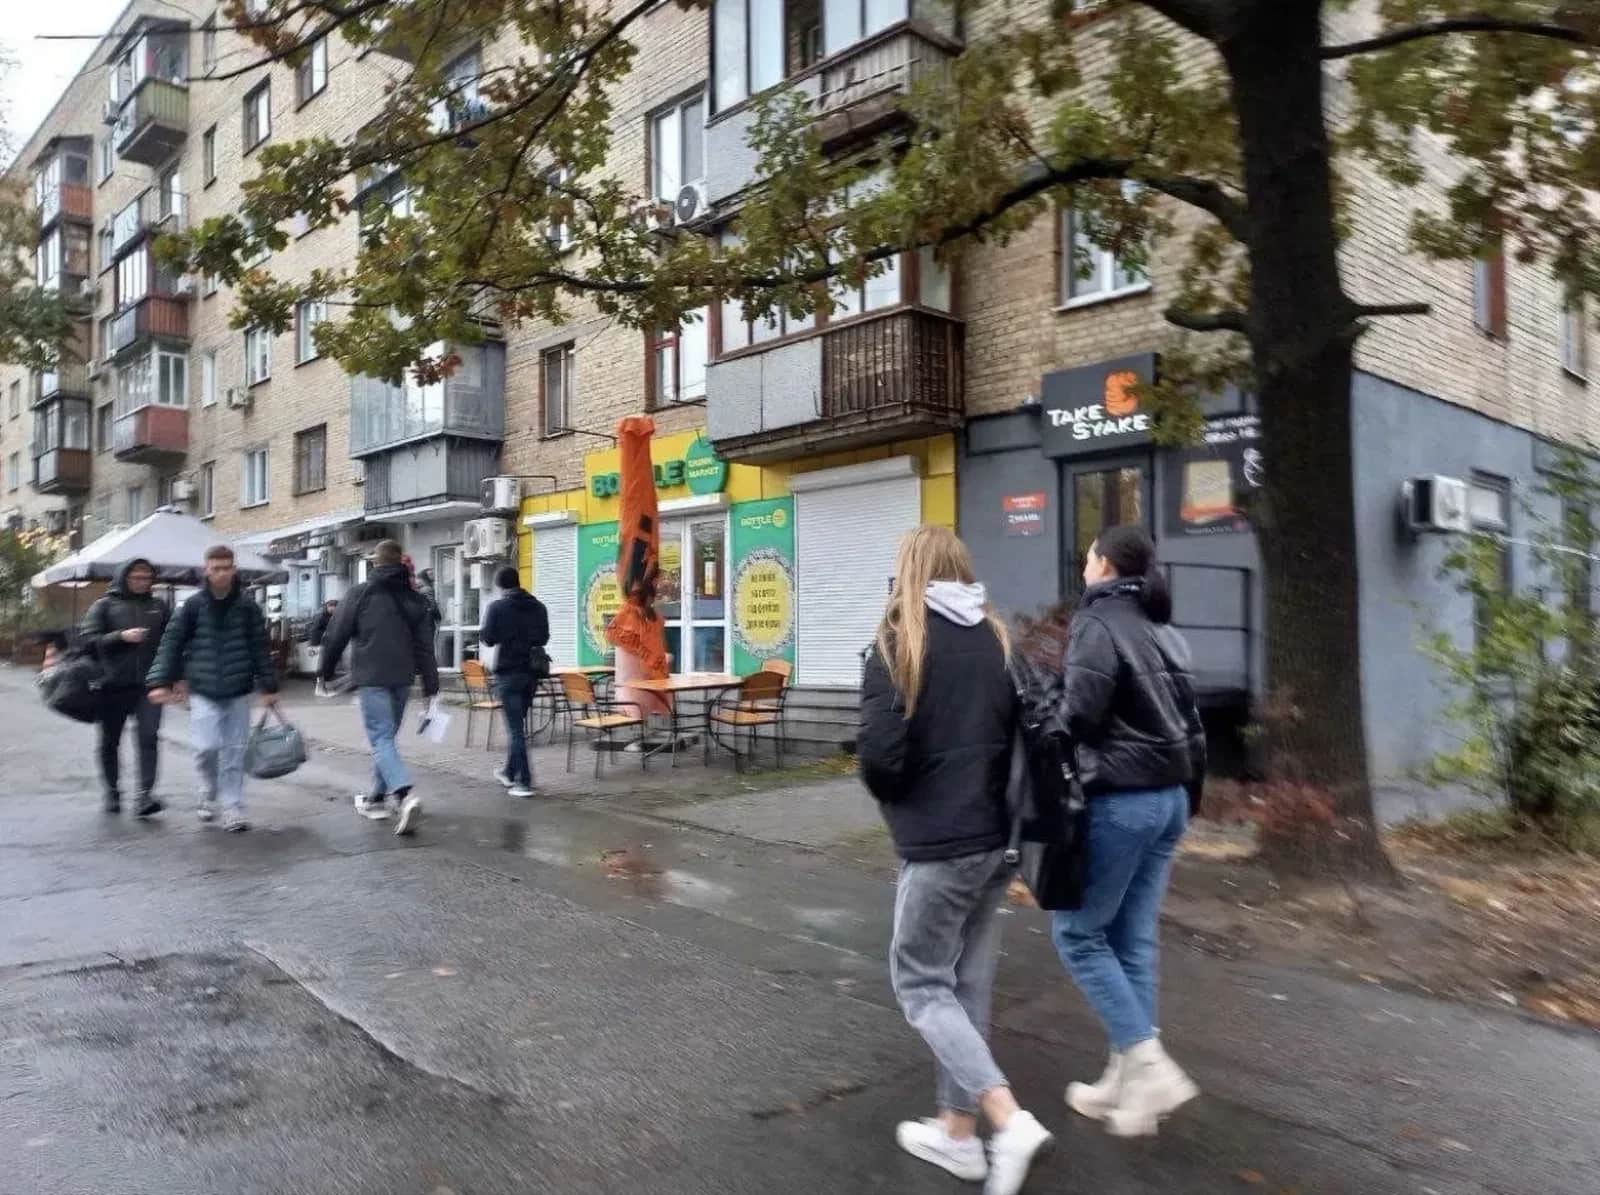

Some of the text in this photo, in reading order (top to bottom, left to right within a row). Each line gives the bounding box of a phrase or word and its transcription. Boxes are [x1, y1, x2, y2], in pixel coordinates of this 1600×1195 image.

[1046, 404, 1105, 427] TAKE
[591, 460, 686, 498] BOLE
[688, 465, 720, 479] MARKET
